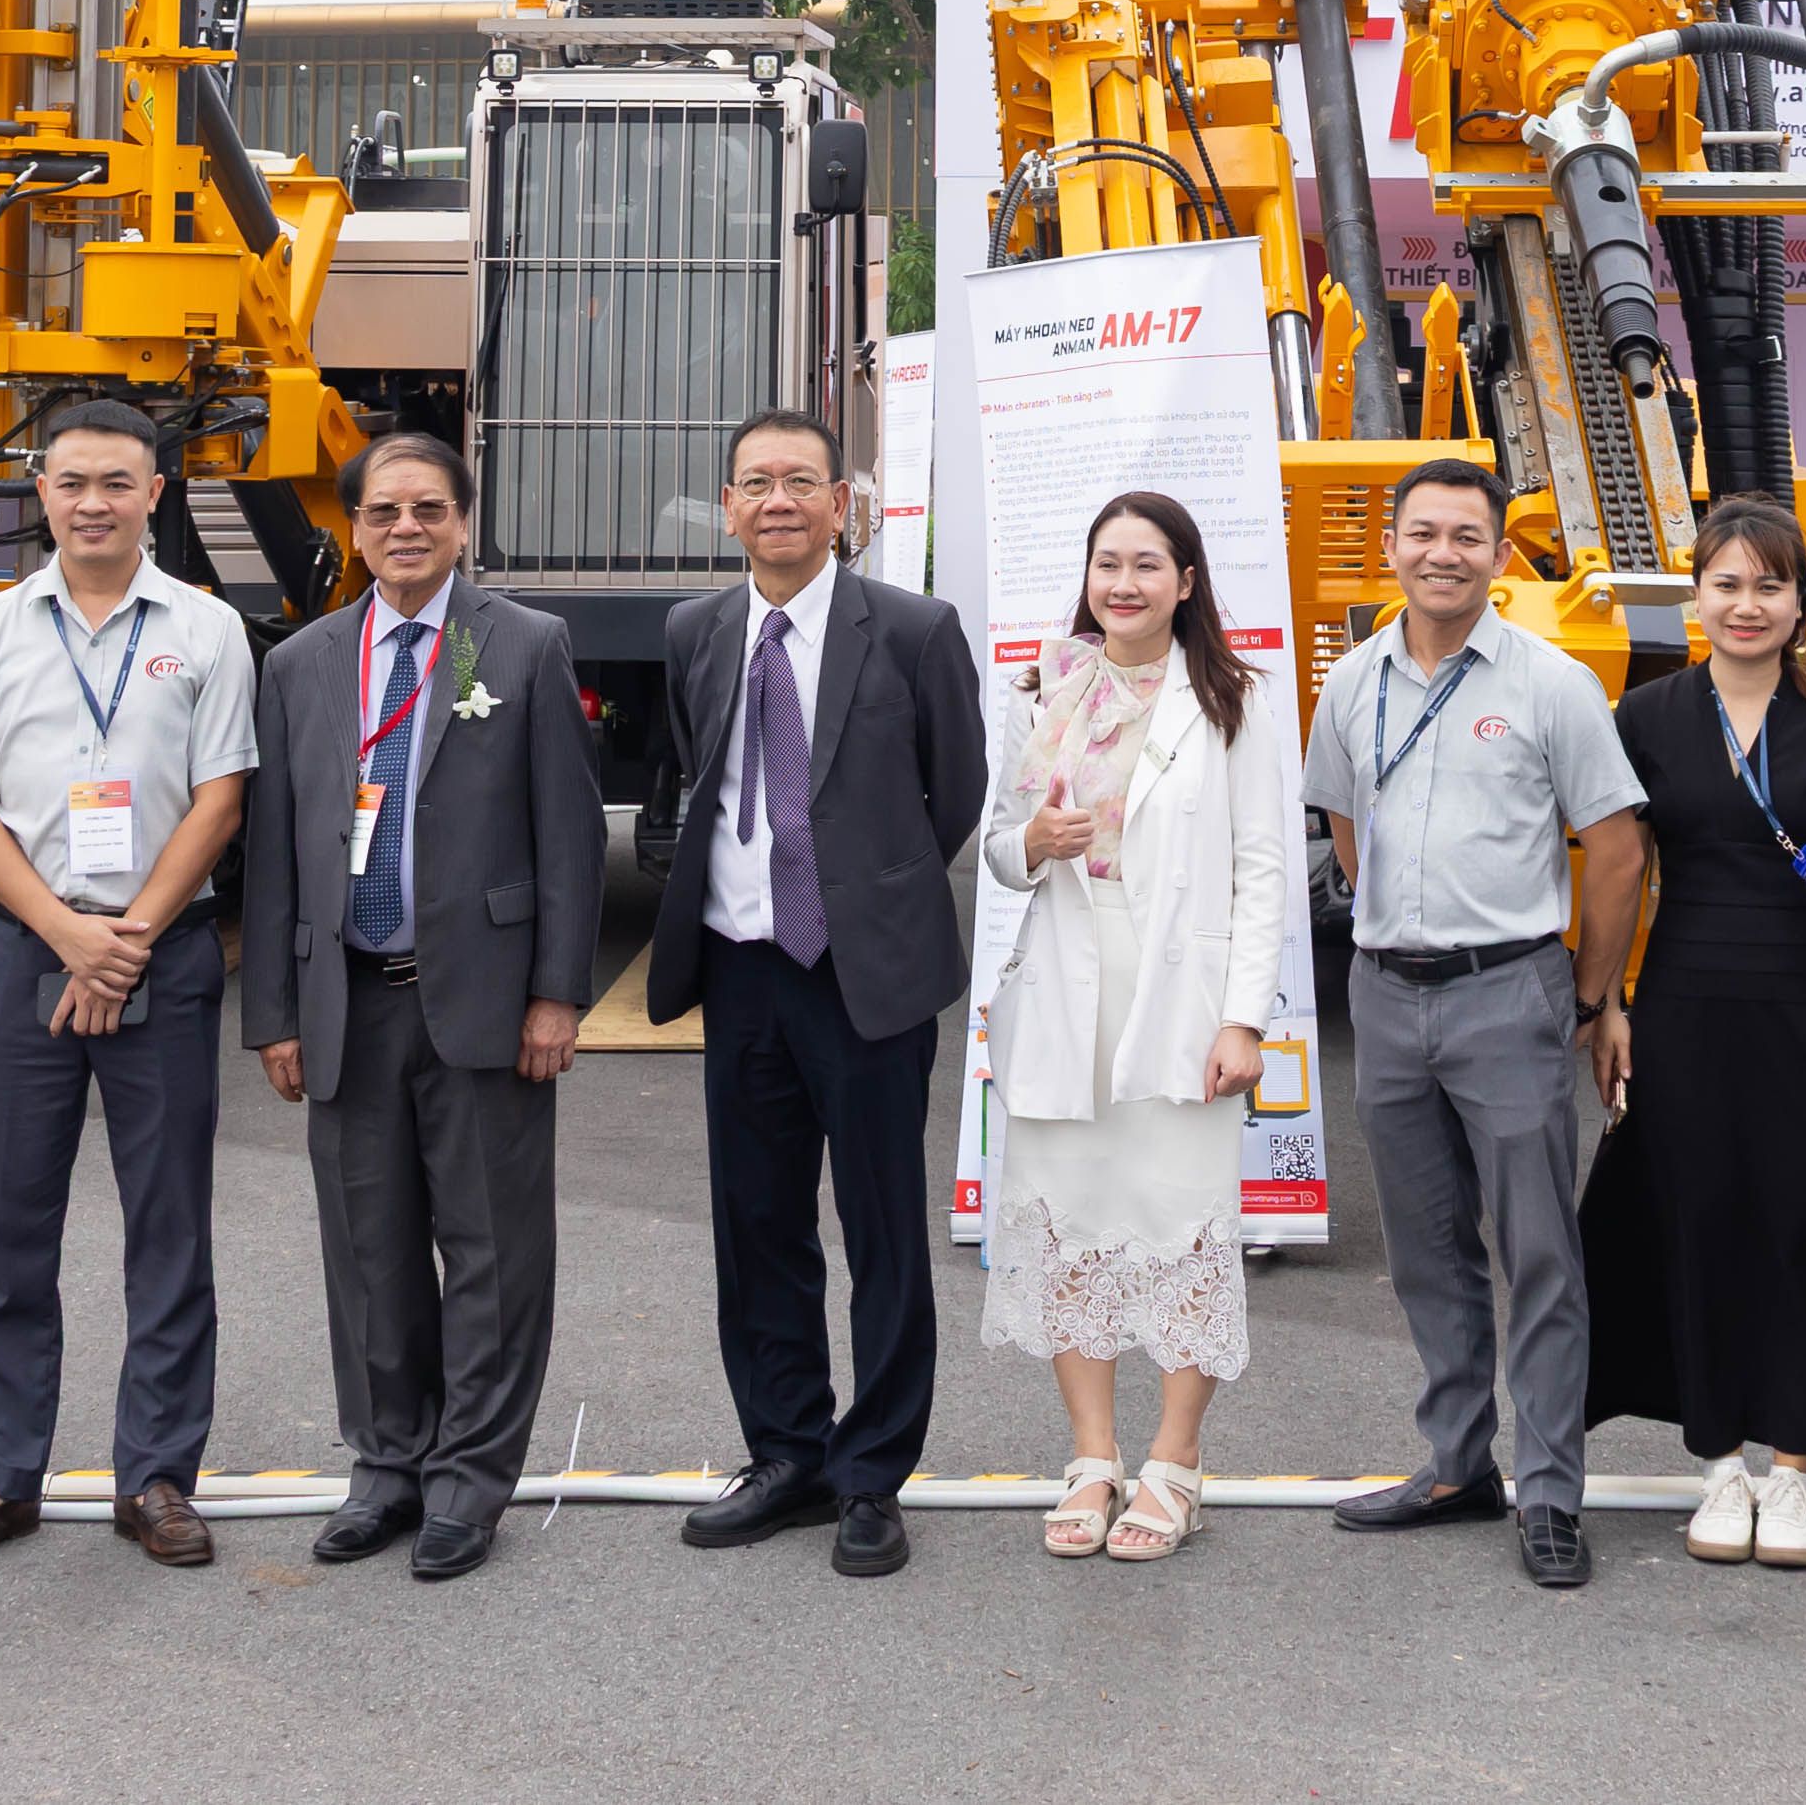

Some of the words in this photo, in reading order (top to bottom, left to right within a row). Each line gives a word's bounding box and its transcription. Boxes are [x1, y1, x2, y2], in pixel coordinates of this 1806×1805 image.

[1385, 263, 1451, 286] THIẾT
[995, 322, 1021, 344] MÁY
[1024, 320, 1066, 340] KHOAN
[1069, 317, 1095, 335] NEO
[1099, 306, 1202, 350] AM-17
[1053, 338, 1095, 357] ANMAN
[153, 661, 180, 675] ATI
[1482, 722, 1507, 737] ATI
